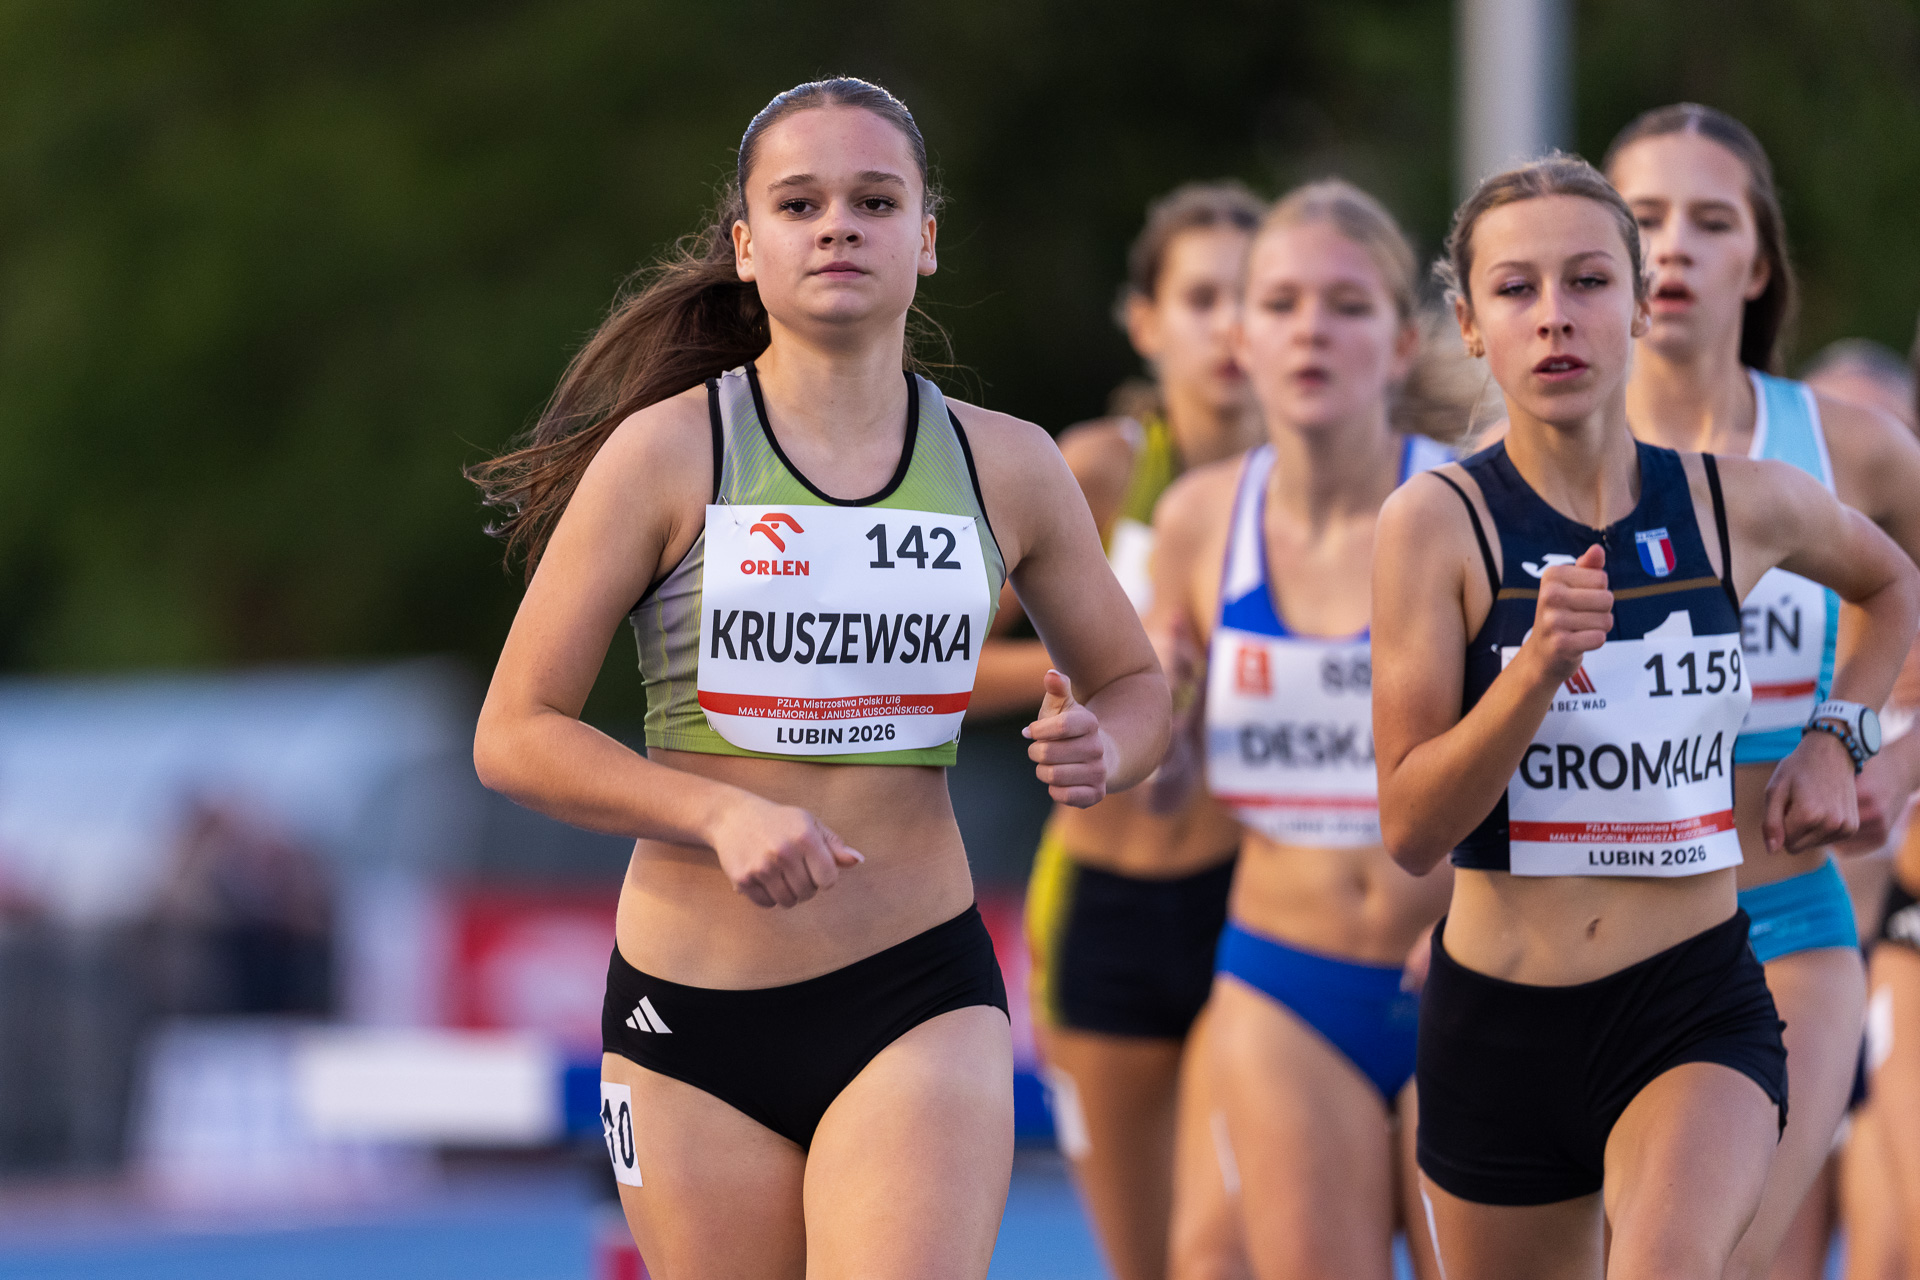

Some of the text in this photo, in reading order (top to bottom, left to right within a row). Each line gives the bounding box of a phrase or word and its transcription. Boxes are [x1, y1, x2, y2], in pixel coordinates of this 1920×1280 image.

[865, 523, 961, 570] 142
[740, 560, 810, 576] ORLEN
[710, 609, 970, 665] KRUSZEWSKA
[1644, 648, 1742, 698] 1159
[738, 704, 934, 720] MAŁY MEMORIAŁ JANUSZA KUSOCIŃSKIEGO
[777, 696, 901, 709] PZLA Mistrzostwa Polski U16
[1558, 701, 1578, 712] BEZ
[1582, 698, 1607, 710] WAD
[776, 723, 896, 745] LUBIN 2026
[1520, 731, 1723, 791] GROMALA
[1589, 845, 1706, 866] LUBIN 2026
[601, 1098, 634, 1169] 10
